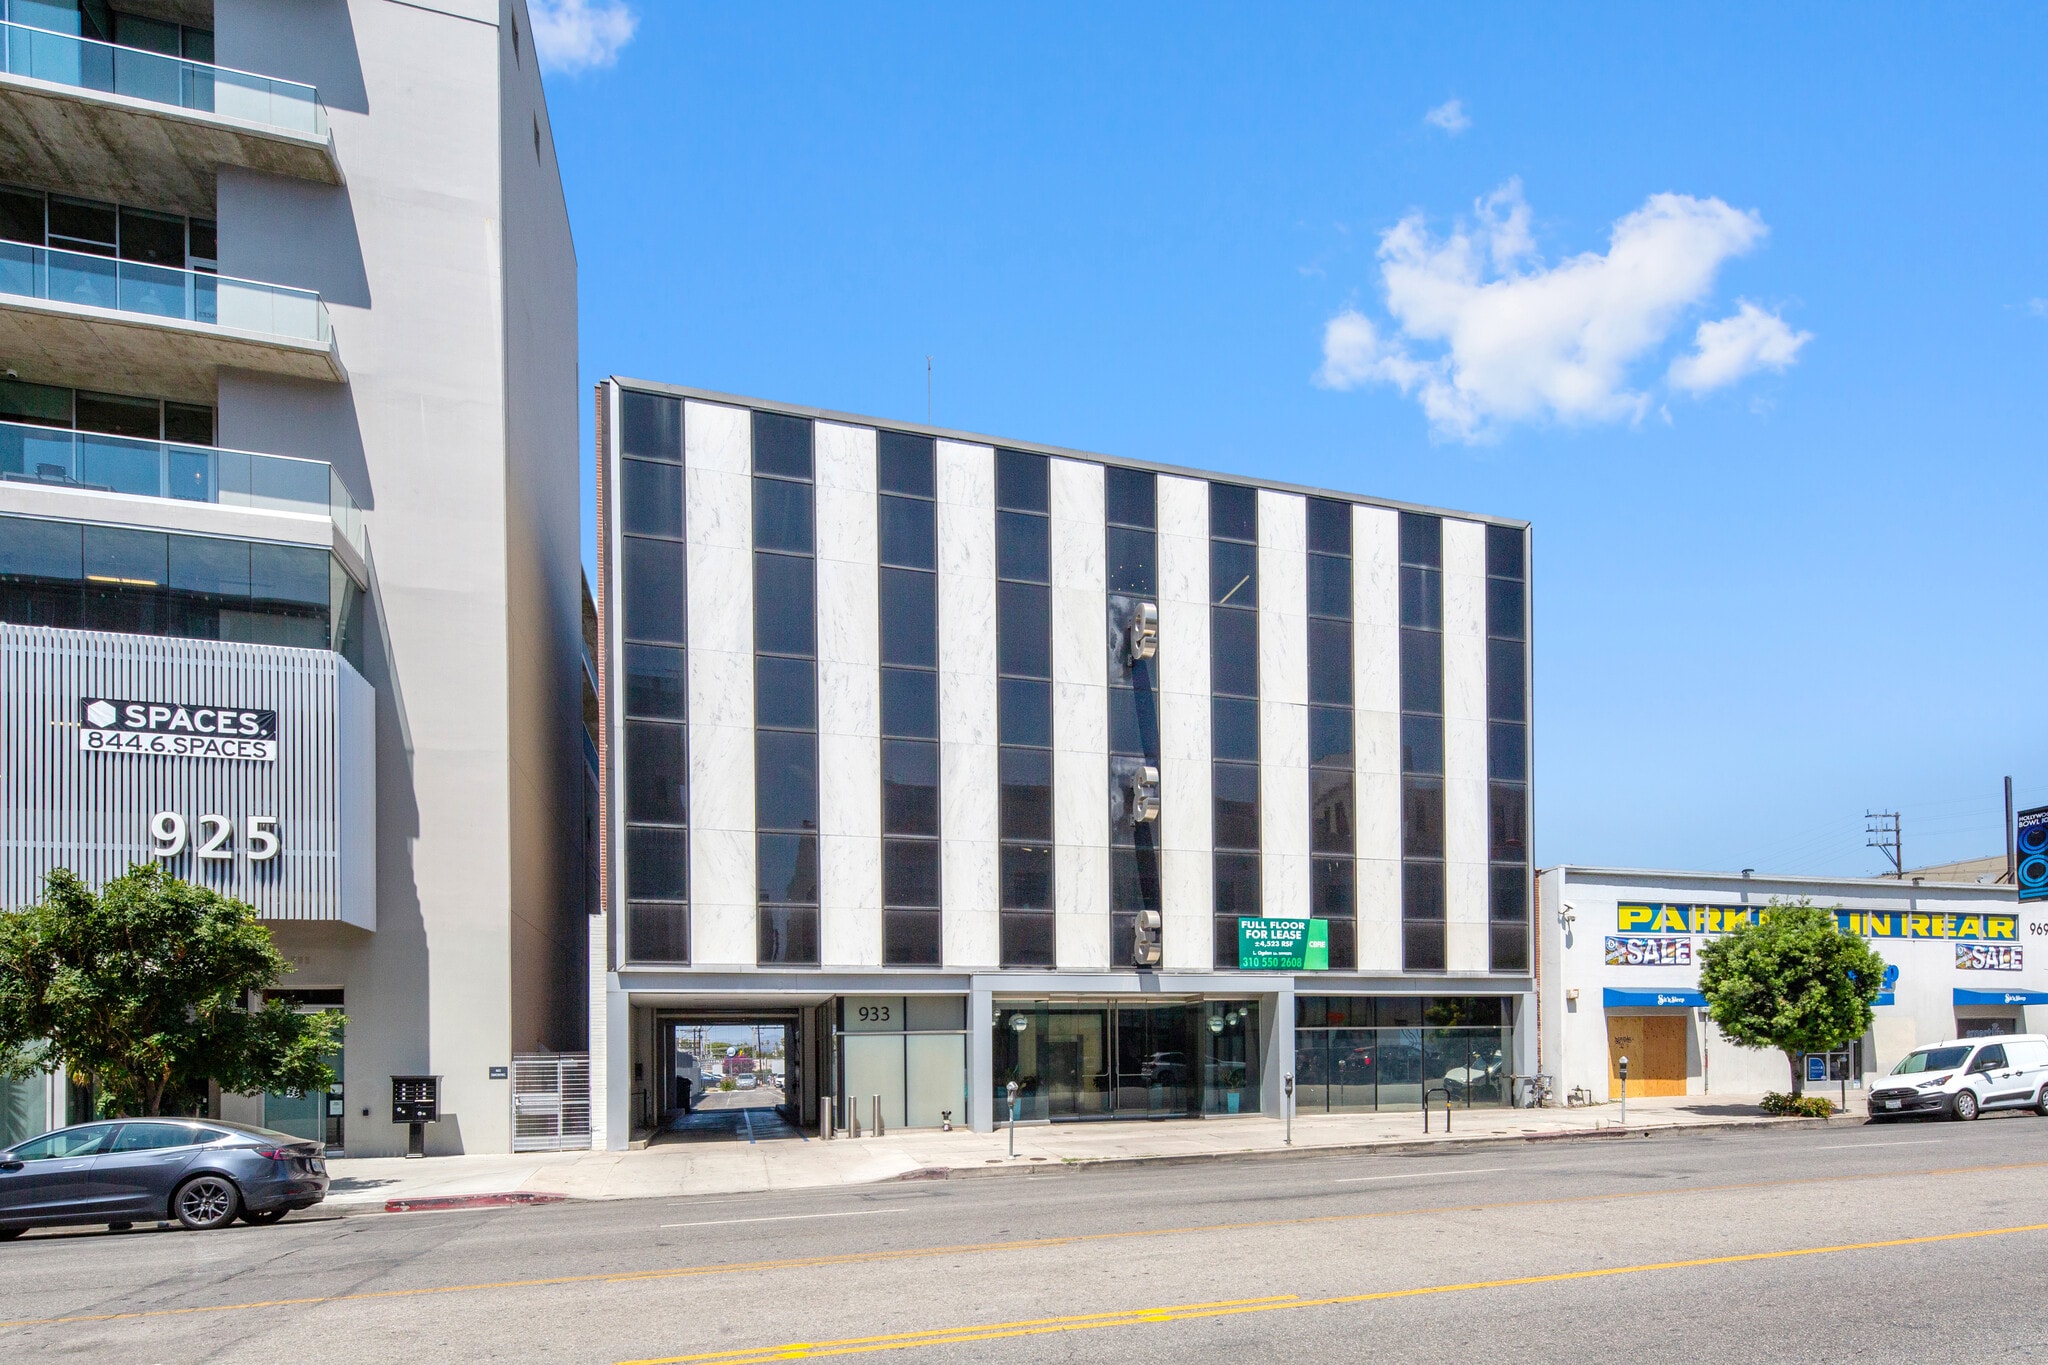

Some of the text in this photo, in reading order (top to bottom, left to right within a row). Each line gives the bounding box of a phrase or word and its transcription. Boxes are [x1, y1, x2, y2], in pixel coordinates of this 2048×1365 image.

[124, 704, 268, 736] SPACES.
[88, 731, 267, 758] 844.6.SPACES
[151, 811, 281, 860] 925
[2018, 818, 2040, 828] BOWL
[1245, 929, 1302, 940] FOR LEASE
[1269, 921, 1305, 930] FLOOR
[1849, 912, 1891, 936] IN
[1902, 913, 2015, 939] REAR
[1242, 957, 1303, 968] 310 550 2608
[1626, 938, 1691, 965] SALE
[1972, 945, 2023, 970] SALE
[858, 1006, 890, 1022] 933
